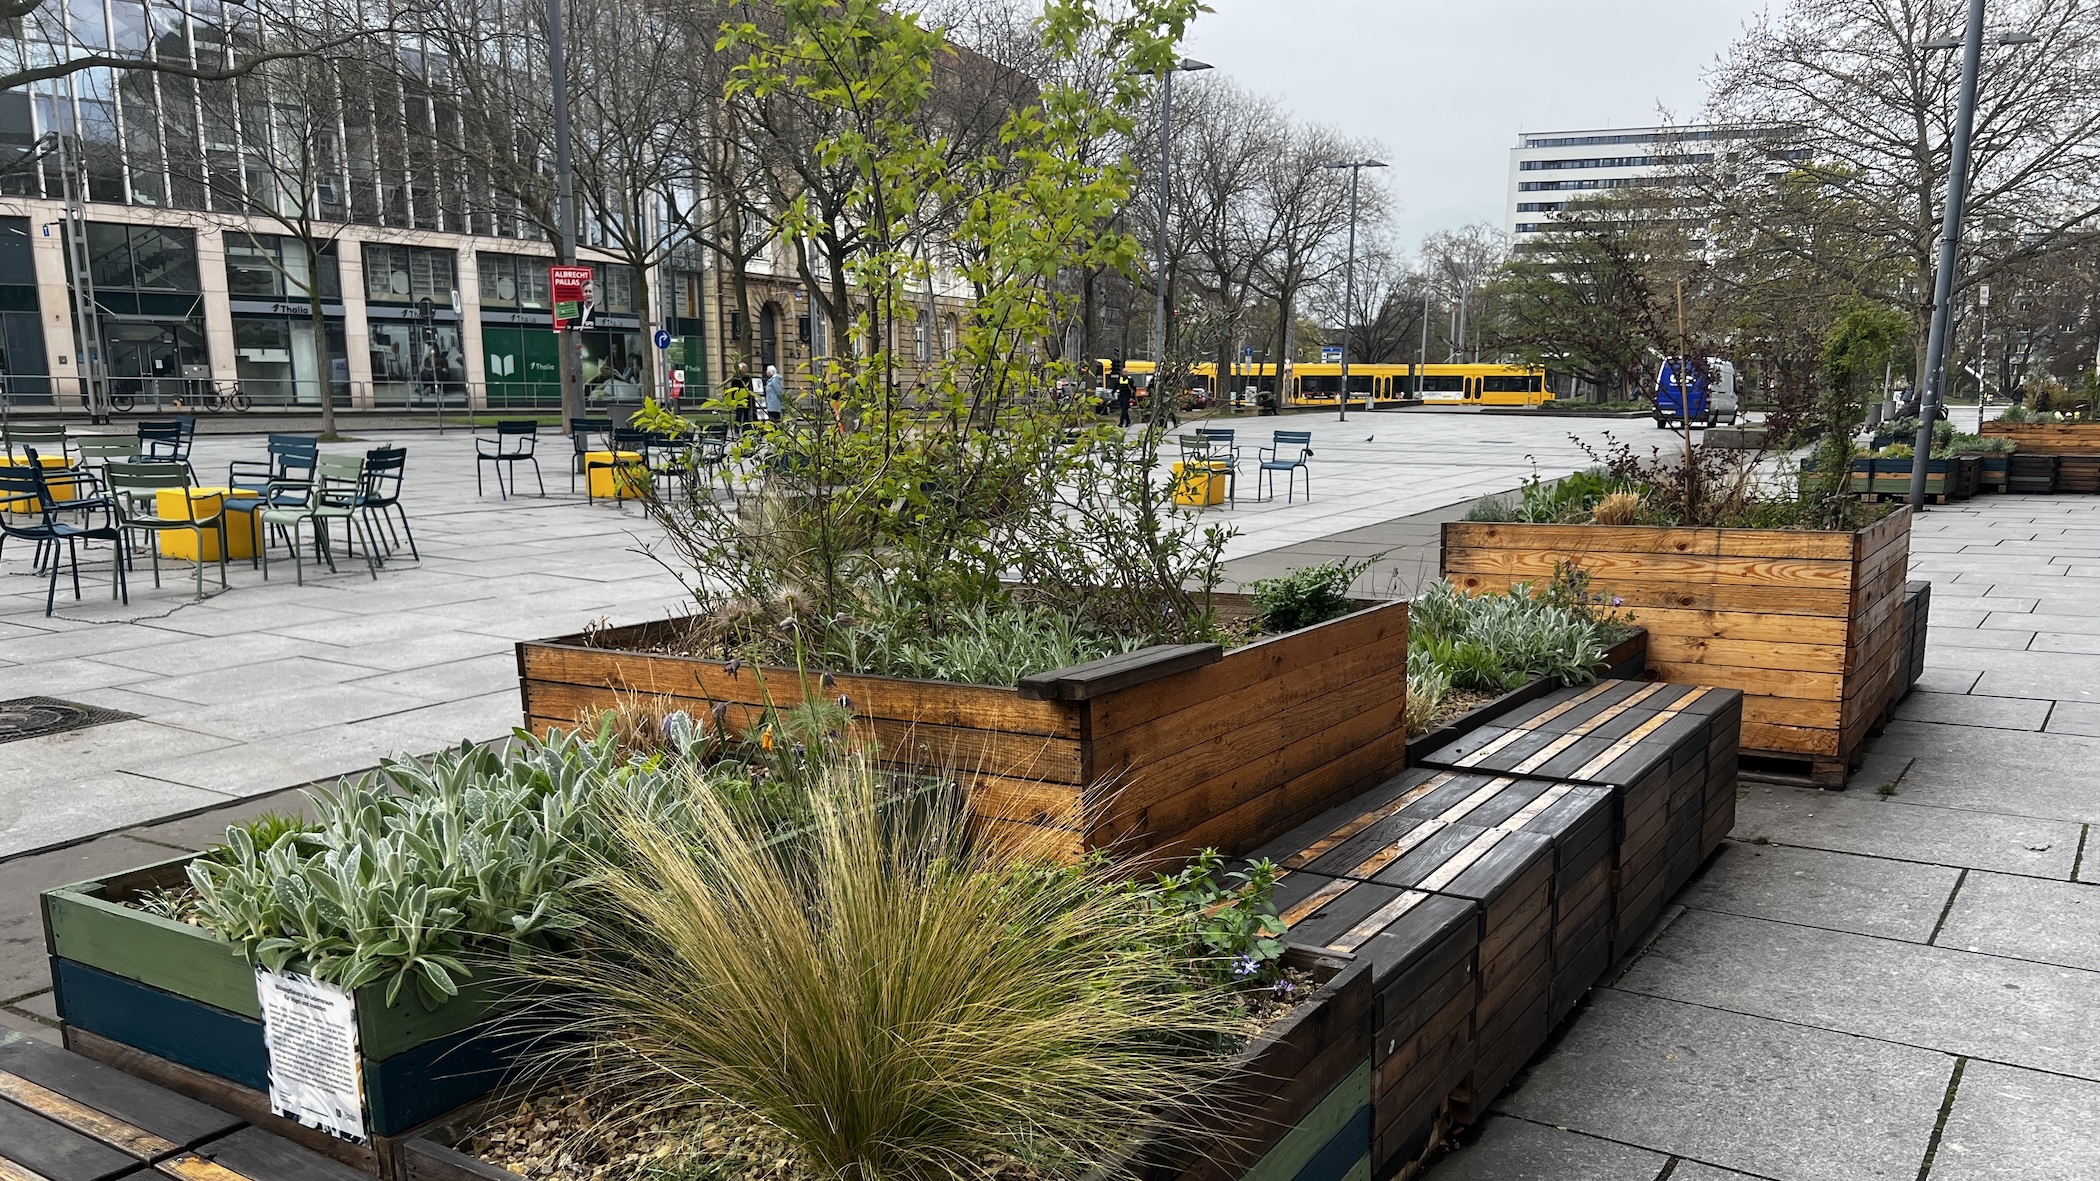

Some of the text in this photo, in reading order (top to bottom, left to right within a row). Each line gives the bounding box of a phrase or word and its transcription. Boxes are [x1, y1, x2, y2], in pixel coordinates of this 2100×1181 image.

[555, 271, 588, 279] ALBRECHT
[280, 305, 308, 314] Thalia
[536, 363, 555, 371] Thalia
